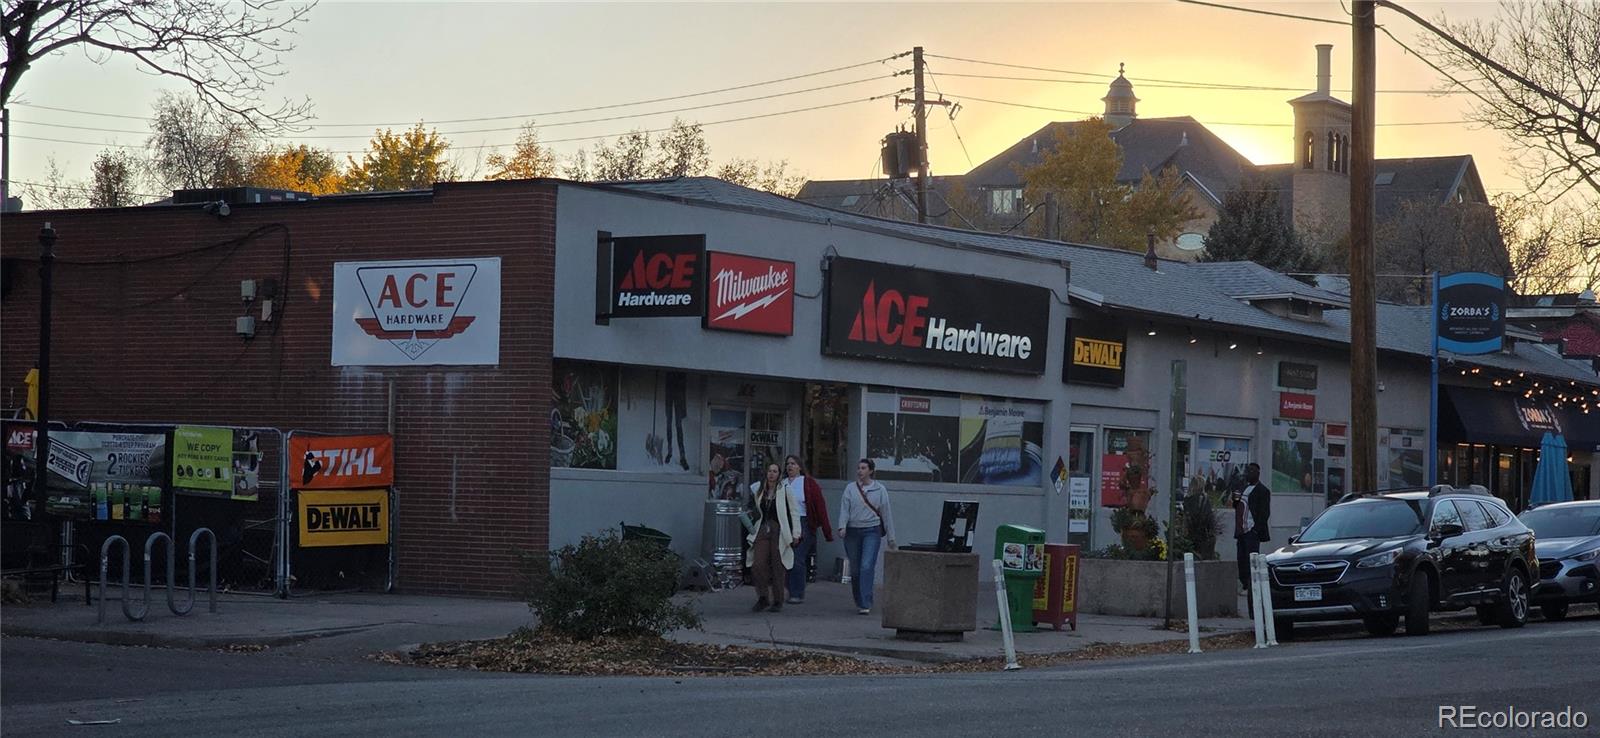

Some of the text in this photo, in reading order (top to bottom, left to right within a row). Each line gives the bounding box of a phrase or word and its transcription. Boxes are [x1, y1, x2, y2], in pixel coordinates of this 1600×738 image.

[618, 248, 697, 290] ACE
[377, 272, 456, 309] ACE
[712, 265, 790, 309] Milwaukee
[617, 291, 692, 307] Hardware
[386, 313, 444, 325] HARDWARE
[847, 277, 1032, 361] ACE Hardware
[1449, 306, 1490, 317] ZORBA'S
[8, 430, 32, 445] ACE
[186, 442, 222, 452] WE COPY
[48, 453, 56, 465] 2
[107, 452, 117, 475] 2
[118, 452, 150, 465] ROCKIES
[302, 447, 382, 477] STIHL
[1209, 450, 1232, 462] EGO
